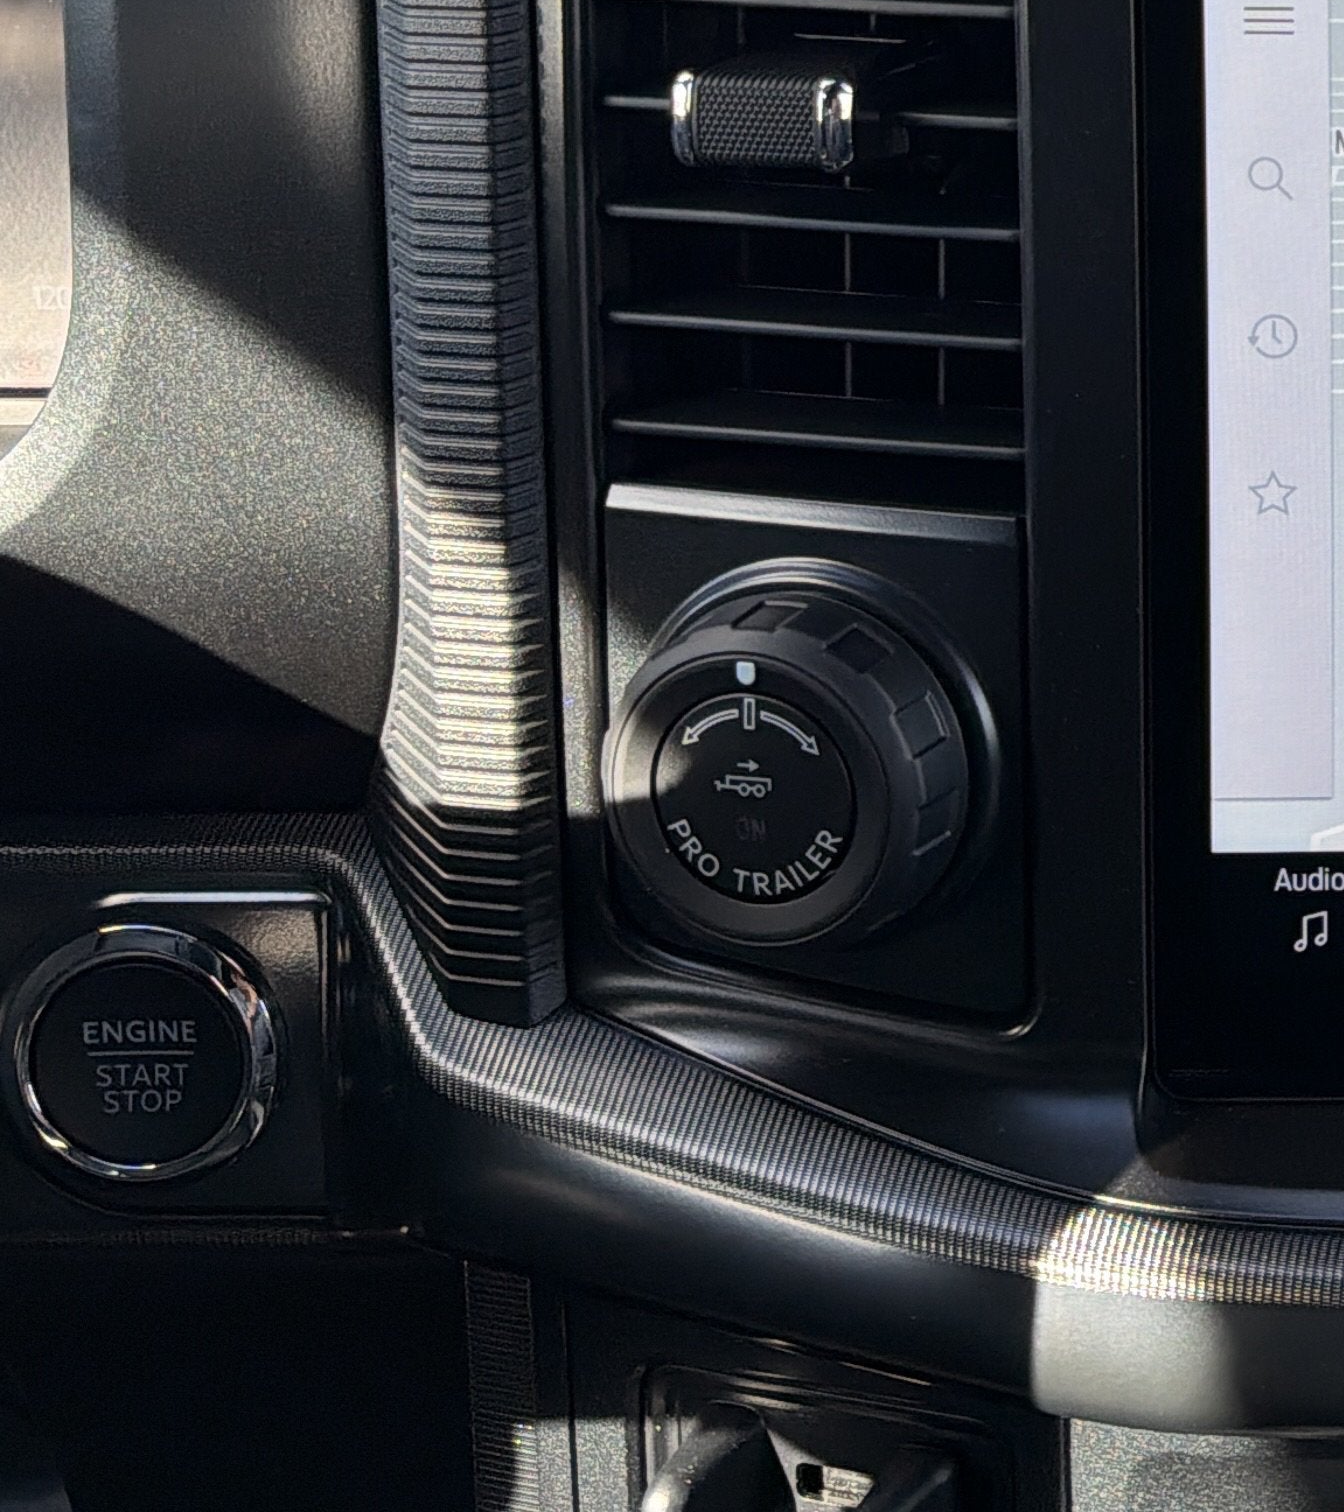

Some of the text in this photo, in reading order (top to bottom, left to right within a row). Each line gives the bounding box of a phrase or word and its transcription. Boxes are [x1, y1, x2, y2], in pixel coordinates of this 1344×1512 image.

[666, 818, 845, 897] PRO TRAILER
[82, 1019, 198, 1044] ENGINE
[96, 1063, 189, 1088] START
[103, 1089, 183, 1114] STOP
